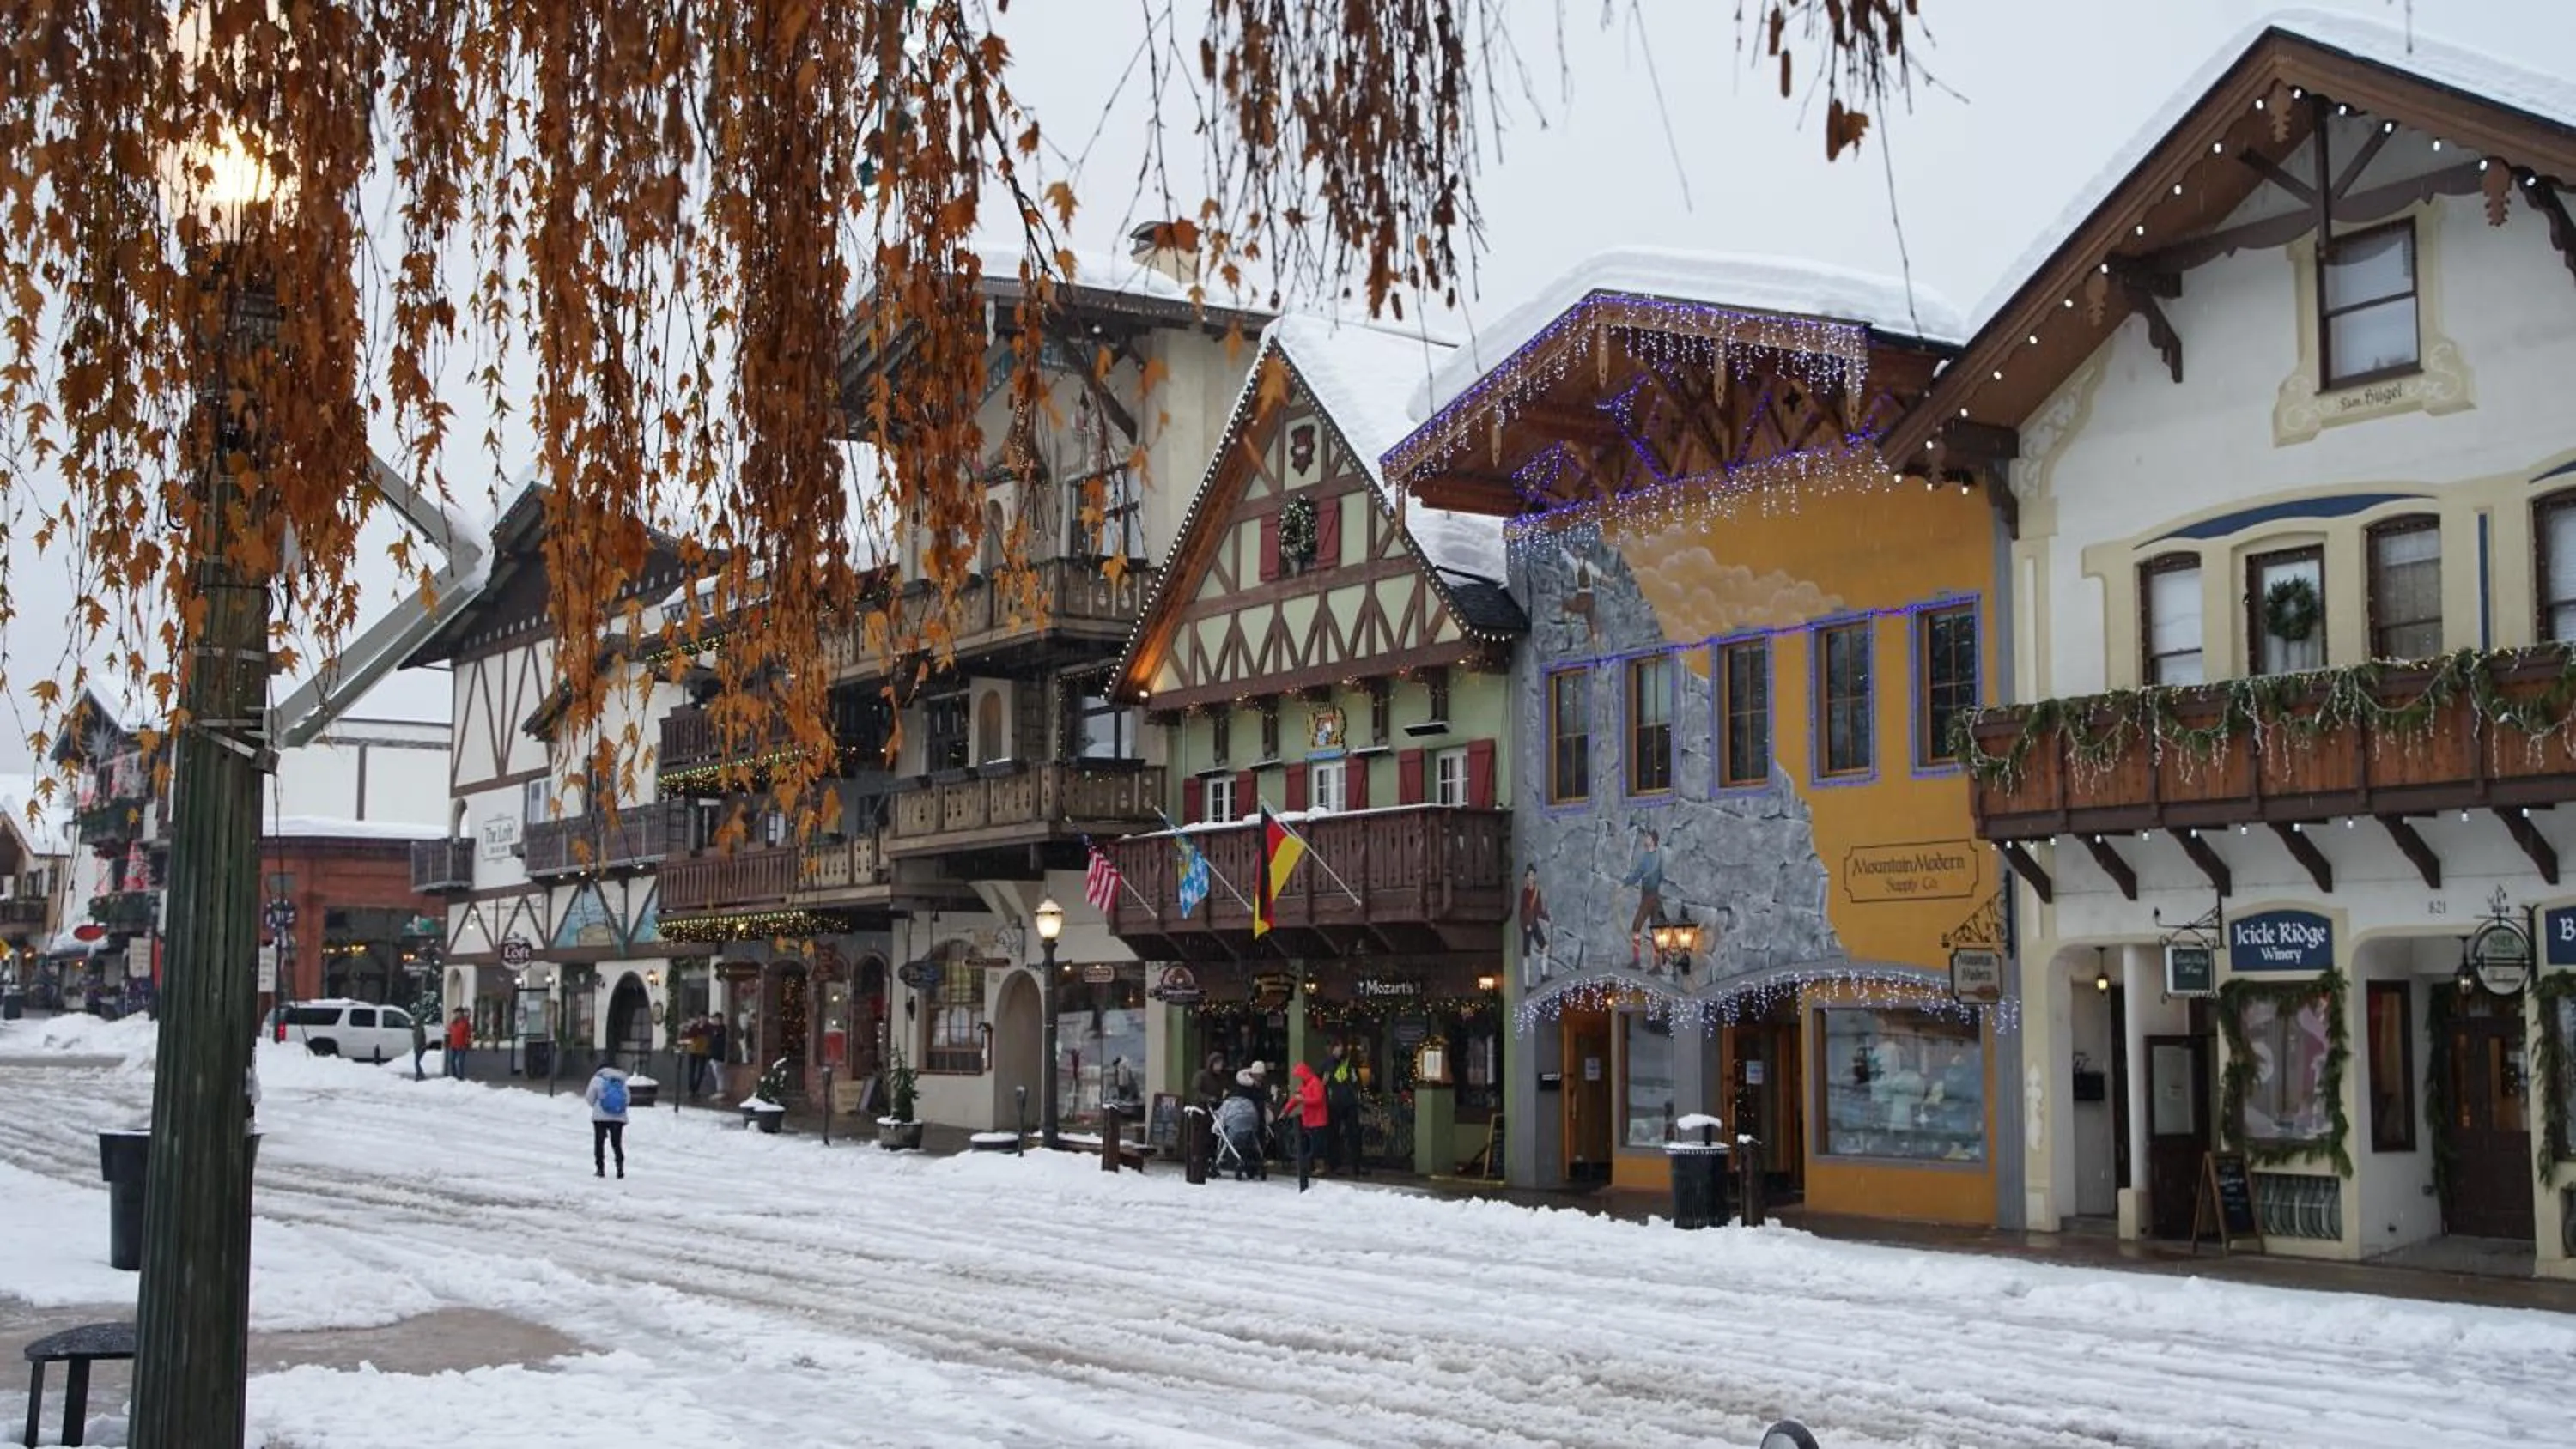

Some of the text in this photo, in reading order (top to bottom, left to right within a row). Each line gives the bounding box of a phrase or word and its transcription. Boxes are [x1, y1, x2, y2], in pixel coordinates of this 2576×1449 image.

[1852, 852, 1965, 877] Mountain Modern
[2235, 920, 2327, 949] Icicle Ridge
[2559, 916, 2576, 942] B
[504, 945, 530, 960] Loft
[2260, 946, 2302, 964] Winery
